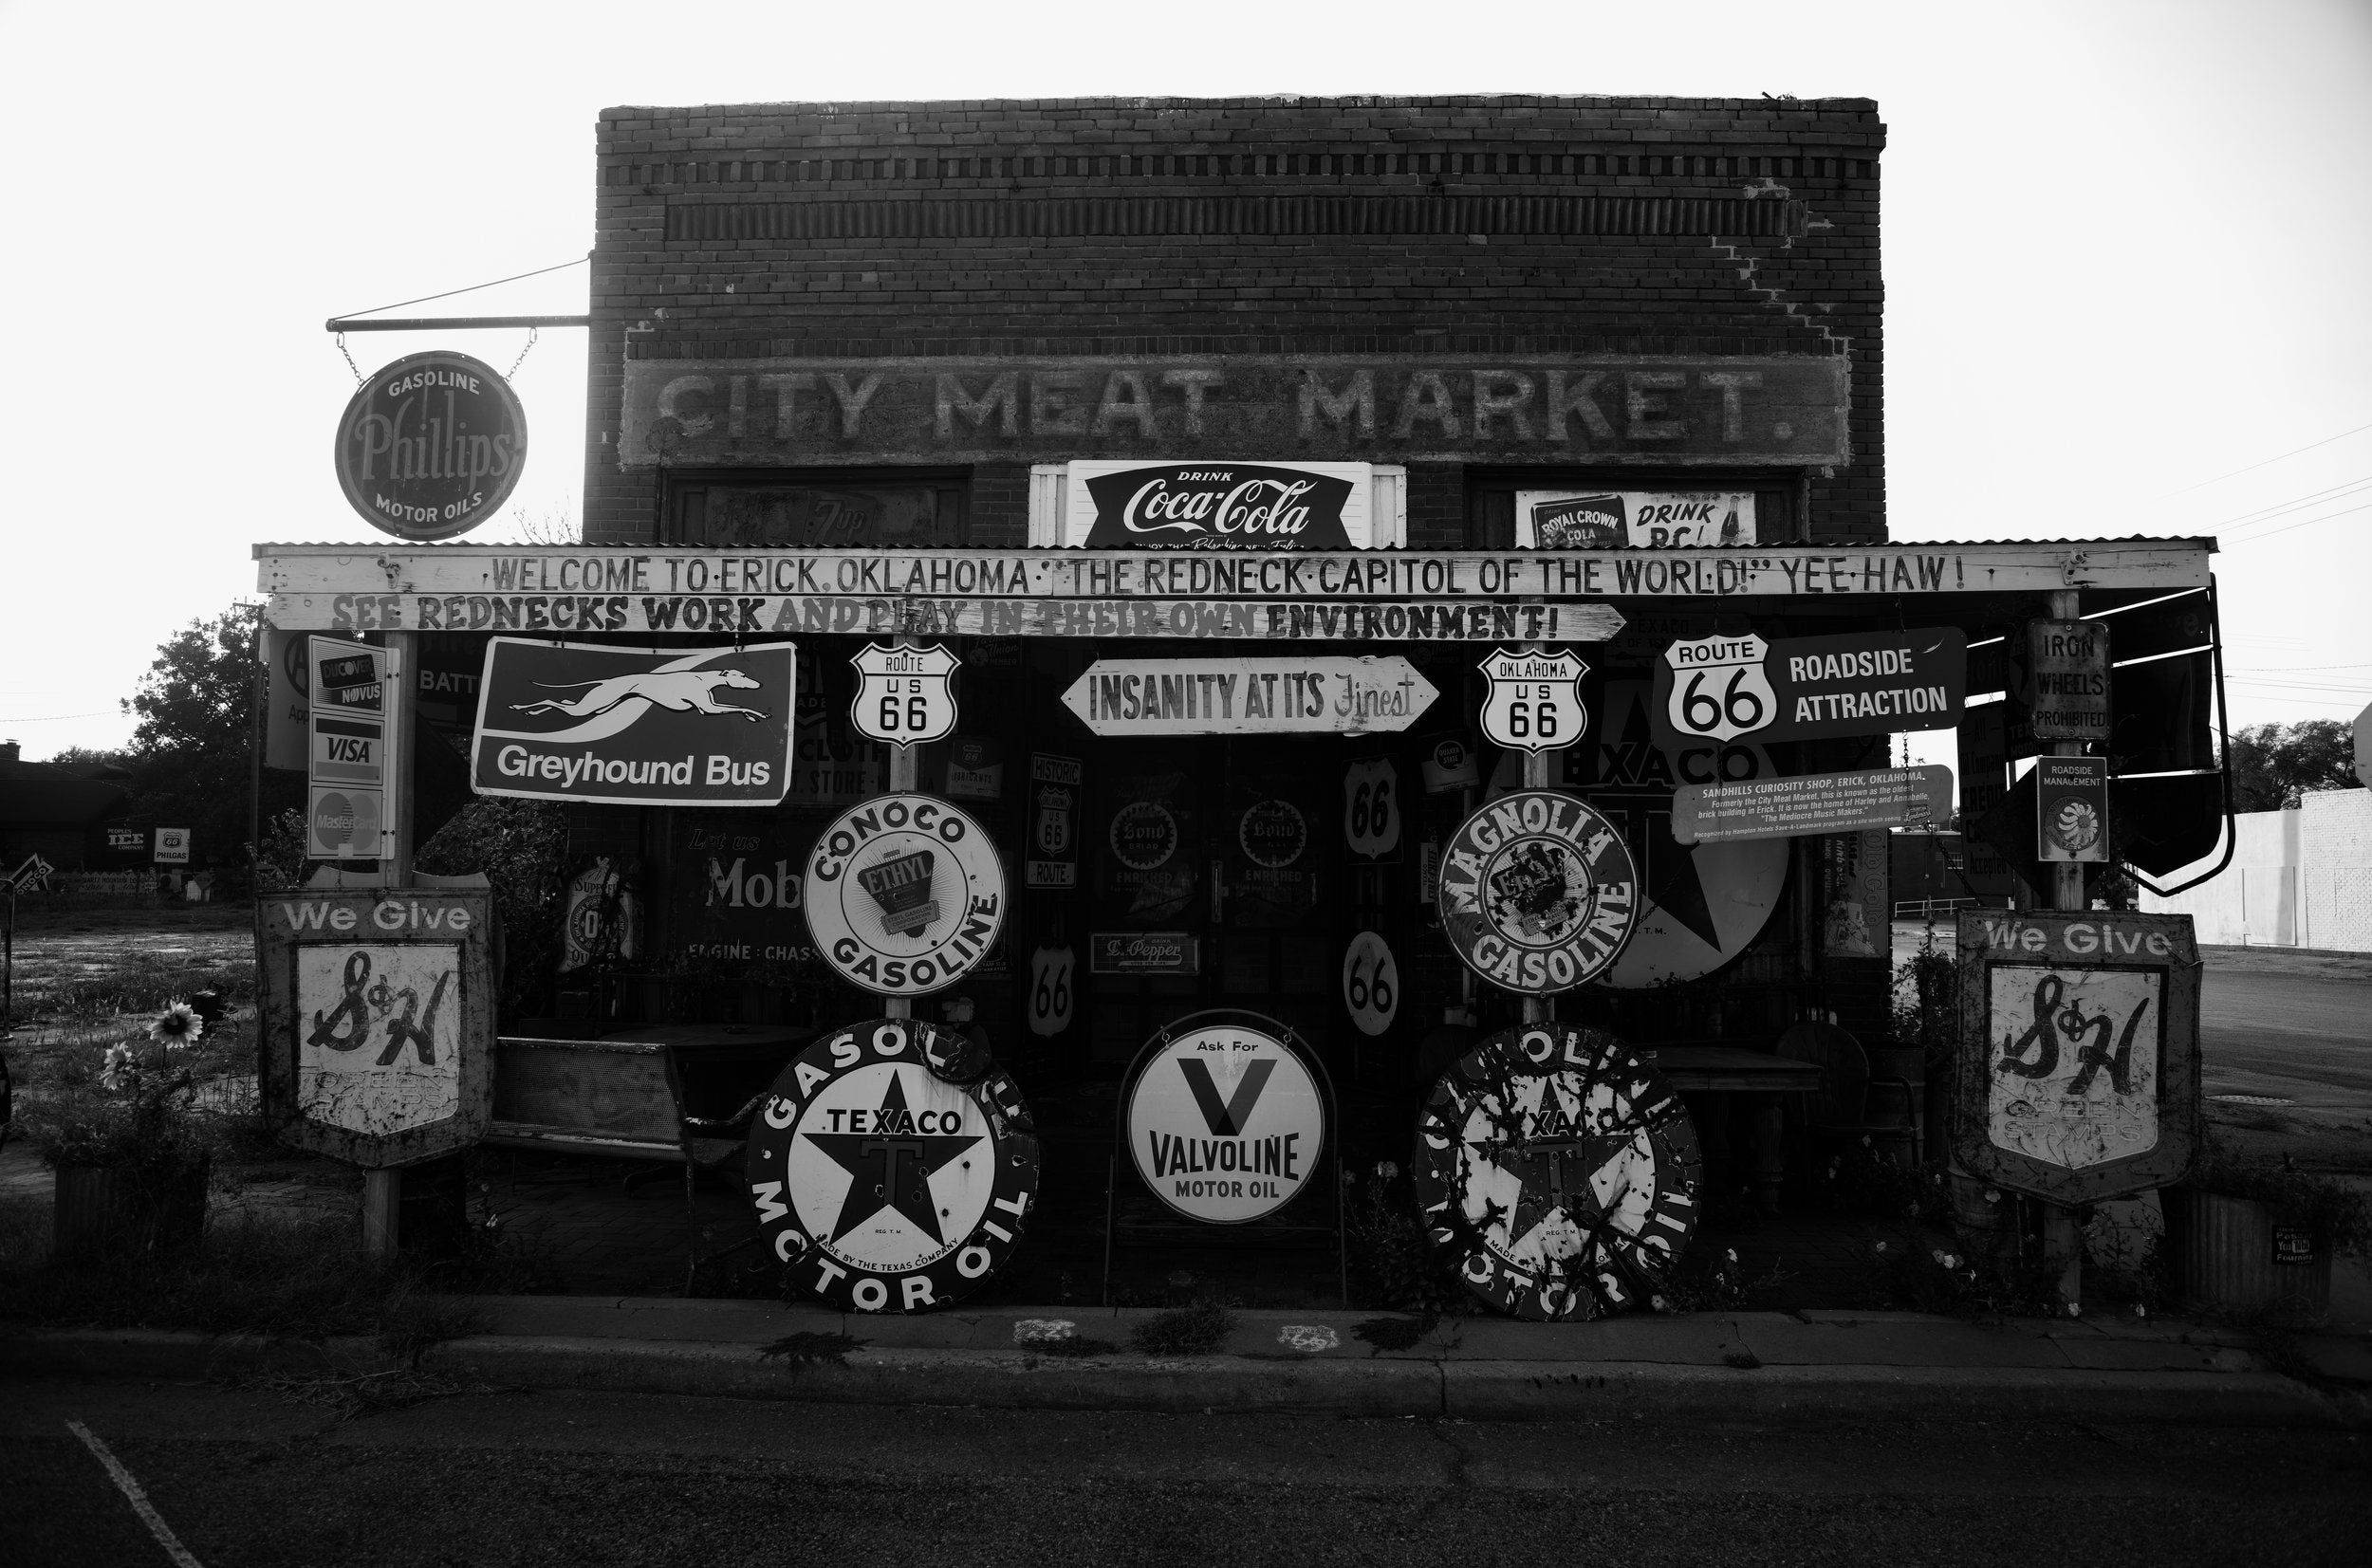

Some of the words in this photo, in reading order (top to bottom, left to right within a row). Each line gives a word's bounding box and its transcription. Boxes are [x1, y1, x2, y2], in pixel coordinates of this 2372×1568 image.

[388, 371, 480, 397] GASOLINE
[658, 371, 885, 440] CITY
[933, 368, 1229, 440] MEAT
[1298, 368, 1794, 442] MARKET.
[355, 391, 512, 494] Phillips
[1177, 471, 1233, 481] DRINK
[376, 493, 437, 522] MOTOR
[444, 491, 482, 519] OILS
[1123, 478, 1318, 534] Coca-Cola
[1637, 503, 1715, 526] DRINK
[1541, 512, 1576, 533] ROYAL
[1577, 509, 1619, 530] CROWN
[1567, 528, 1596, 541] COLA
[492, 556, 650, 592] WELCOME
[837, 558, 1031, 595] OKLAHOMA
[1144, 559, 1312, 595] REDNECK
[1320, 559, 1457, 595] CAPITOL
[1480, 559, 1523, 595] OF
[1535, 559, 1604, 595] THE
[1780, 556, 1851, 594] YEE
[332, 596, 402, 630] SEE
[417, 596, 629, 632] REDNECKS
[642, 598, 766, 633] WORK
[771, 598, 861, 633] AND
[866, 600, 966, 636] PLAY
[980, 600, 1025, 636] IN
[1042, 600, 1162, 636] THEIR
[1170, 602, 1259, 638] OWN
[1267, 600, 1558, 639] ENVIRONMENT!
[1678, 641, 1755, 664] ROUTE
[2045, 635, 2094, 657] IRON
[886, 656, 923, 673] ROUTE
[1499, 662, 1568, 679] OKLAHOMA
[1789, 648, 1915, 683] ROADSIDE
[342, 685, 380, 704] NOVUS
[1089, 673, 1237, 721] INSANITY
[1245, 673, 1278, 719] AT
[1284, 671, 1325, 718] ITS
[1334, 672, 1416, 718] Finest
[2037, 673, 2103, 696] WHEELS
[880, 696, 926, 730] 66
[1682, 667, 1764, 732] 66
[1793, 686, 1948, 724] ATTRACTION
[1510, 703, 1557, 738] 66
[2037, 711, 2105, 728] PROHIBITED
[327, 737, 370, 764] VISA
[497, 745, 695, 789] Greyhound
[706, 754, 770, 786] Bus
[1036, 760, 1079, 784] HISTORIC
[2051, 766, 2093, 775] ROADSIDE
[1702, 785, 1752, 799] SANDHILLS
[1755, 781, 1804, 794] CURIOSITY
[1807, 779, 1834, 790] SHOP,
[1837, 776, 1866, 787] ERICK,
[1869, 771, 1926, 784] OKLAHOMA.
[1712, 798, 1743, 808] Formerly
[1745, 797, 1756, 805] the
[1758, 796, 1771, 805] City
[1773, 794, 1791, 803] Meat
[1821, 790, 1834, 799] this
[1844, 788, 1868, 798] known
[1880, 785, 1891, 795] the
[1892, 784, 1914, 793] oldest
[2044, 778, 2102, 786] MANAGEMENT
[1352, 780, 1389, 839] 66
[1697, 810, 1715, 819] brick
[1717, 807, 1746, 818] building
[1793, 802, 1808, 811] now
[1810, 801, 1822, 809] the
[1824, 799, 1844, 808] home
[1845, 798, 1853, 806] of
[1855, 796, 1877, 806] Harley
[1878, 795, 1892, 803] and
[1778, 811, 1812, 821] Mediocre
[1813, 808, 1835, 819] Music
[316, 815, 378, 831] MasterCard
[1045, 825, 1062, 846] 66
[1695, 829, 1723, 839] Recognized
[1823, 820, 1845, 828] program
[732, 835, 760, 850] us
[815, 801, 966, 882] CONOCO
[1445, 797, 1615, 916] MAGNOLIA
[864, 856, 933, 895] ETHYL
[1036, 863, 1066, 884] ROUTE
[284, 901, 358, 931] We
[374, 901, 471, 931] Give
[833, 895, 998, 987] GASOLINE
[1473, 881, 1632, 988] GASOLINE
[1985, 920, 2048, 951] We
[2063, 923, 2173, 956] Give
[1126, 938, 1183, 962] Pepper
[1035, 963, 1068, 1019] 66
[1349, 954, 1393, 1013] 66
[306, 950, 450, 1066] S&H
[1196, 1041, 1225, 1052] Ask
[1232, 1041, 1259, 1052] For
[1996, 974, 2150, 1096] S&H
[1177, 1058, 1278, 1136] V
[827, 1108, 962, 1135] TEXACO
[2003, 1121, 2142, 1142] STAMPS
[1149, 1130, 1299, 1182] VALVOLINE
[1176, 1180, 1243, 1198] MOTOR
[1250, 1181, 1280, 1198] OIL
[751, 1181, 936, 1311] MOTOR
[955, 1190, 1029, 1279] OIL
[843, 1254, 855, 1264] BY
[858, 1260, 878, 1270] THE
[881, 1262, 913, 1272] TEXAS
[915, 1237, 959, 1266] COMPANY
[1490, 1240, 1516, 1262] MADE
